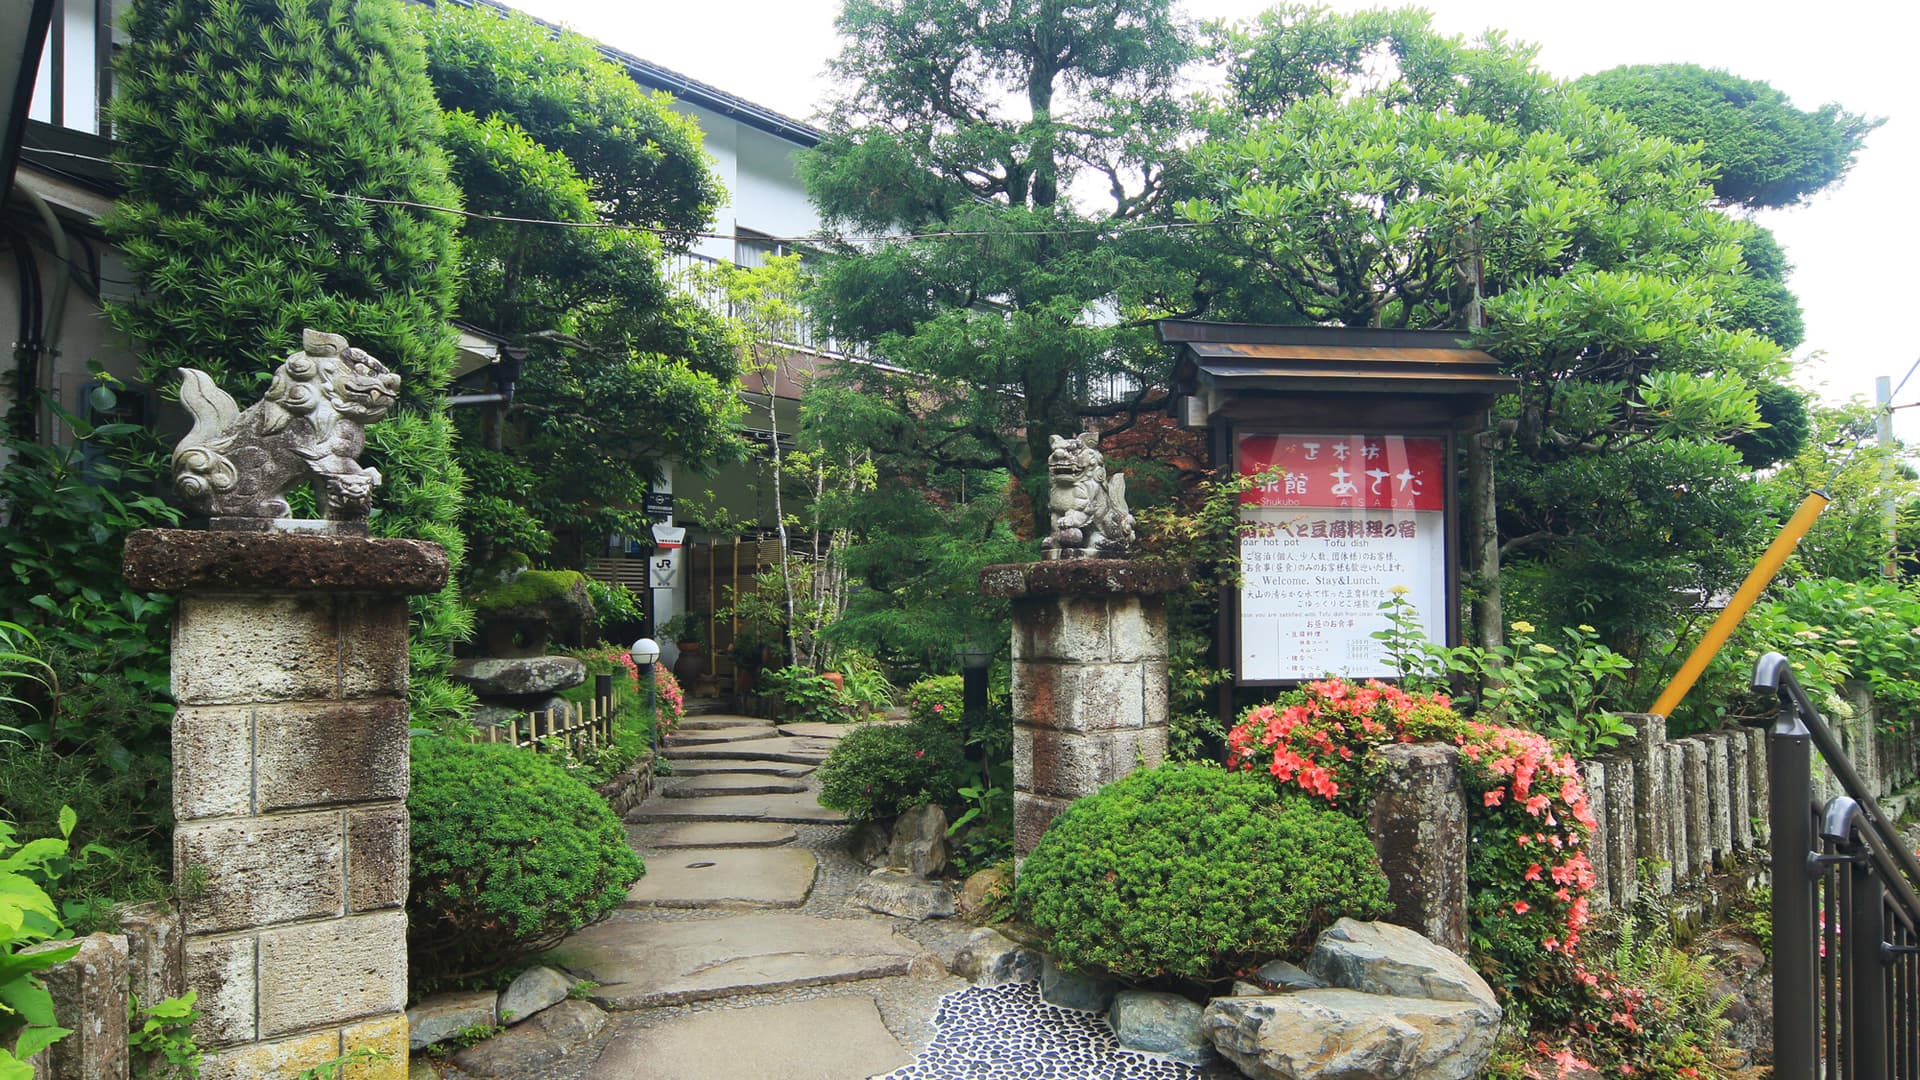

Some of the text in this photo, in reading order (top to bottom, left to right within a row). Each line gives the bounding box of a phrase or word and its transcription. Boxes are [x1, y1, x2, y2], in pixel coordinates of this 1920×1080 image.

[1302, 442, 1381, 461] 正本坊
[1329, 466, 1424, 497] あさだ
[1260, 497, 1414, 507] Shukubo ASADA
[1264, 538, 1279, 546] hot
[1284, 538, 1300, 548] pot
[1324, 539, 1346, 547] Tofu
[1351, 539, 1369, 547] dish
[656, 559, 671, 569] JR
[1262, 575, 1380, 587] Welcome. Stay&Lunch.
